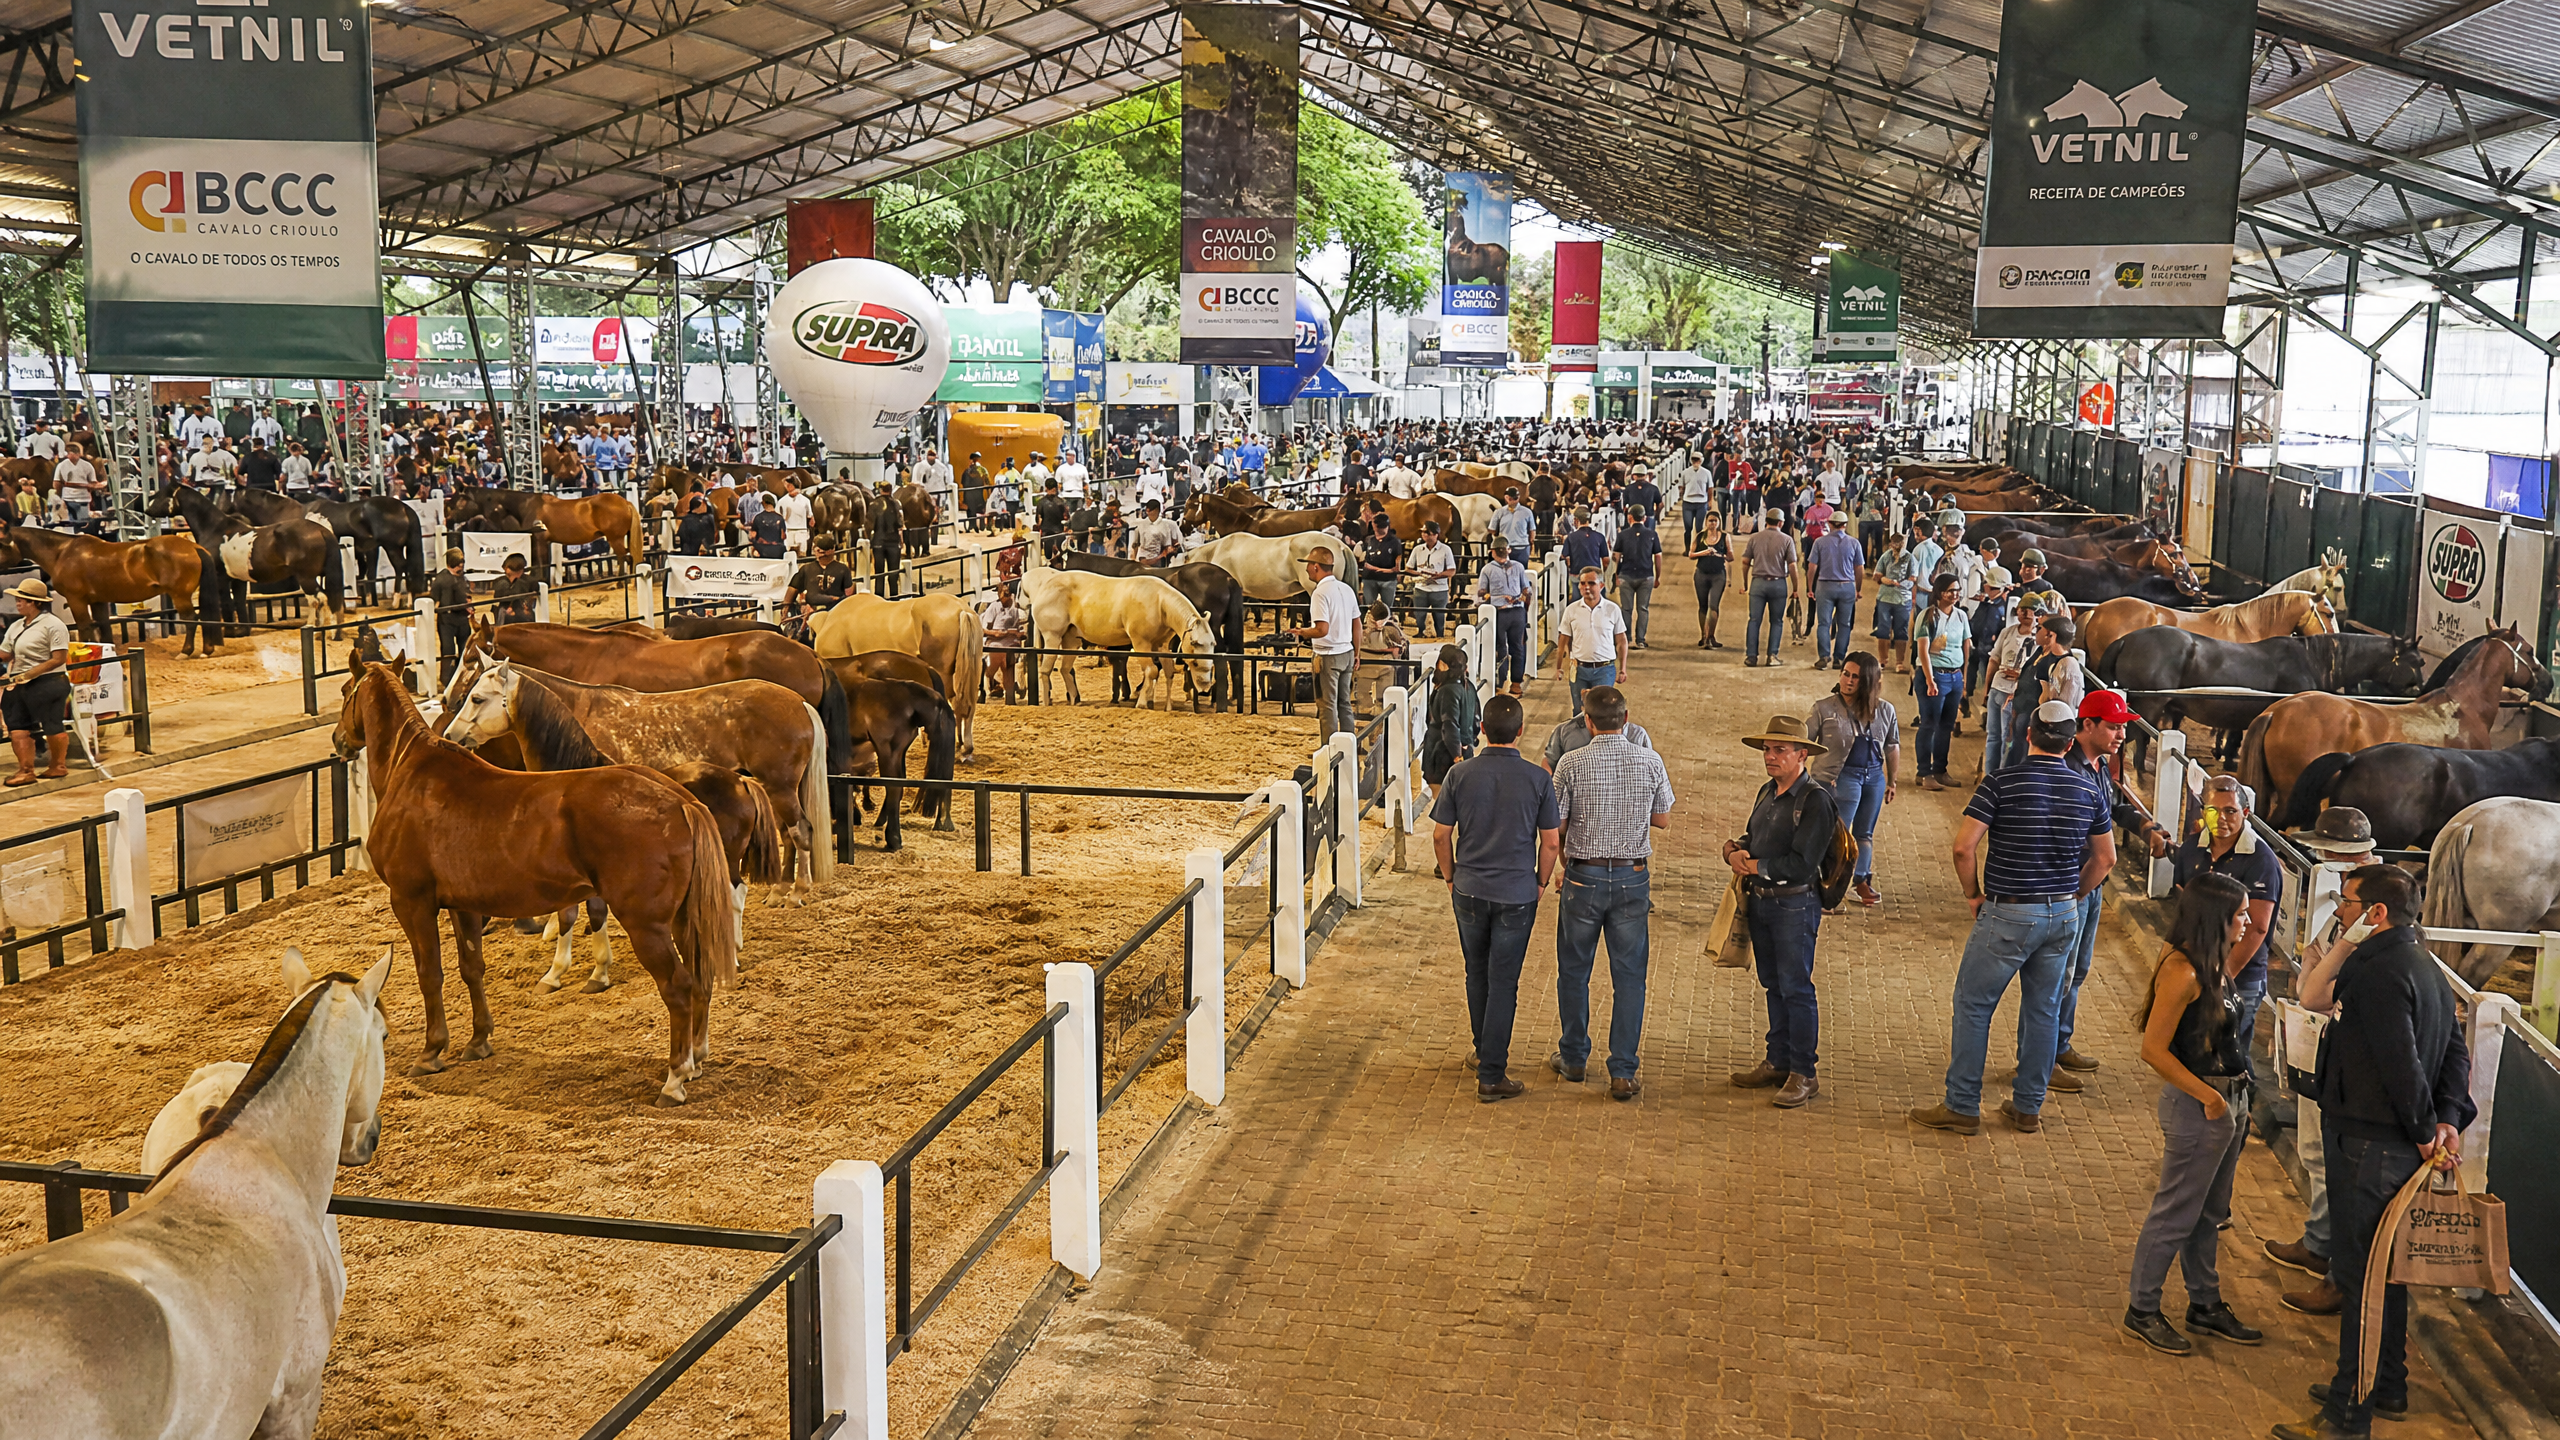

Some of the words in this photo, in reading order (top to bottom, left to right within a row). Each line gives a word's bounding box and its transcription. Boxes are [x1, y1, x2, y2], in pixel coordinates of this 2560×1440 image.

[99, 12, 346, 63] VETNIL
[2030, 131, 2190, 164] VETNIL
[2028, 186, 2085, 201] RECEITA
[2088, 186, 2107, 199] DE
[2110, 182, 2186, 199] CAMPEÕES
[197, 222, 263, 237] CAVALO
[269, 223, 340, 238] CRIOULO
[1202, 227, 1268, 245] CAVALO
[130, 252, 142, 266] O
[144, 252, 200, 267] CAVALO
[202, 253, 221, 267] DE
[223, 253, 268, 268] TODOS
[270, 254, 288, 268] OS
[290, 254, 341, 269] TEMPOS
[1200, 244, 1277, 263] CRIOULO
[1839, 300, 1888, 312] VETNIL
[803, 312, 920, 355] SUPRA
[2431, 541, 2480, 586] SUPRA
